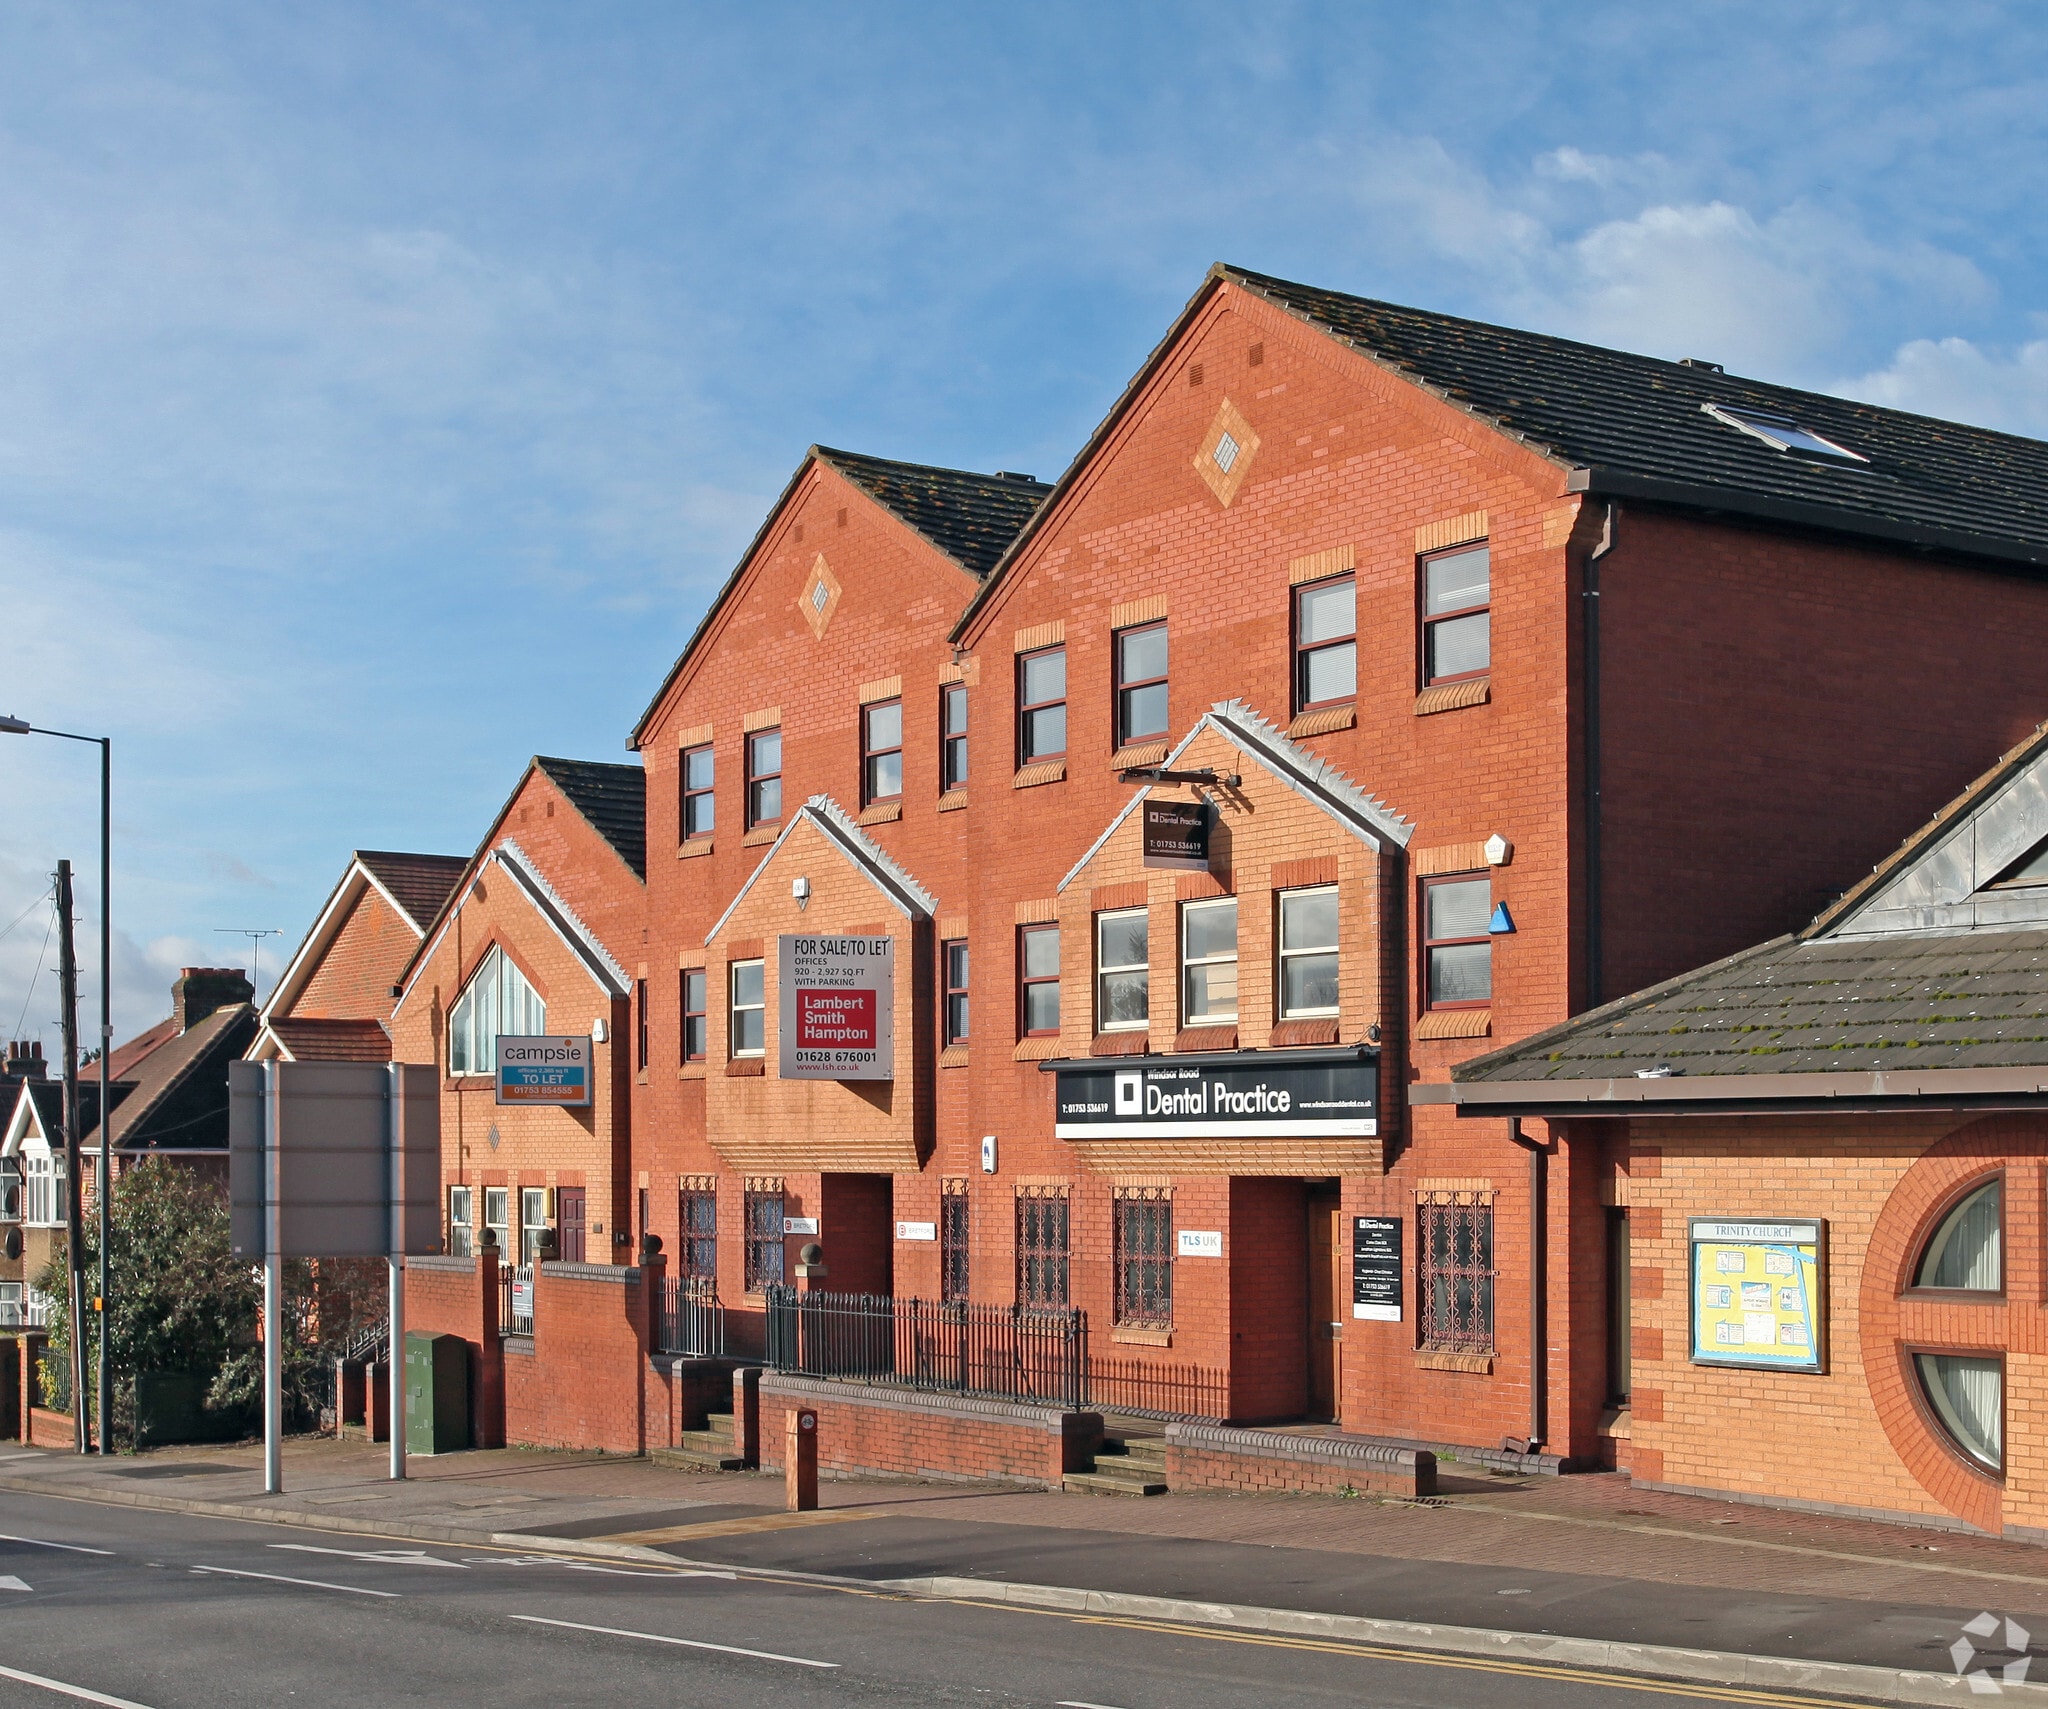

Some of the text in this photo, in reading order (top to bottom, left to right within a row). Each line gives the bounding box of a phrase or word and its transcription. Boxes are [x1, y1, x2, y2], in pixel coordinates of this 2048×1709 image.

[1160, 816, 1202, 826] Dental Practice
[1156, 840, 1176, 849] 01753
[1178, 841, 1201, 850] 536619
[795, 939, 888, 957] FOR SALE/TO LET
[795, 957, 827, 965] OFFICES
[818, 968, 839, 977] 2,927
[842, 968, 865, 977] SQ.FT
[795, 978, 855, 987] WITH PARKING
[804, 996, 864, 1010] Lambert
[805, 1011, 845, 1025] Smith
[804, 1026, 868, 1042] Hampton
[505, 1040, 581, 1063] campsie
[796, 1052, 877, 1062] 01628 676001
[796, 1063, 859, 1071] www.lsh.co.uk
[1147, 1067, 1200, 1080] Windsor Road
[523, 1074, 564, 1084] TO LET
[514, 1086, 573, 1094] 01753 854555
[1146, 1081, 1291, 1115] Dental Practice
[1714, 1225, 1792, 1238] TRINITY CHURCH
[1182, 1235, 1218, 1246] TLS UK
